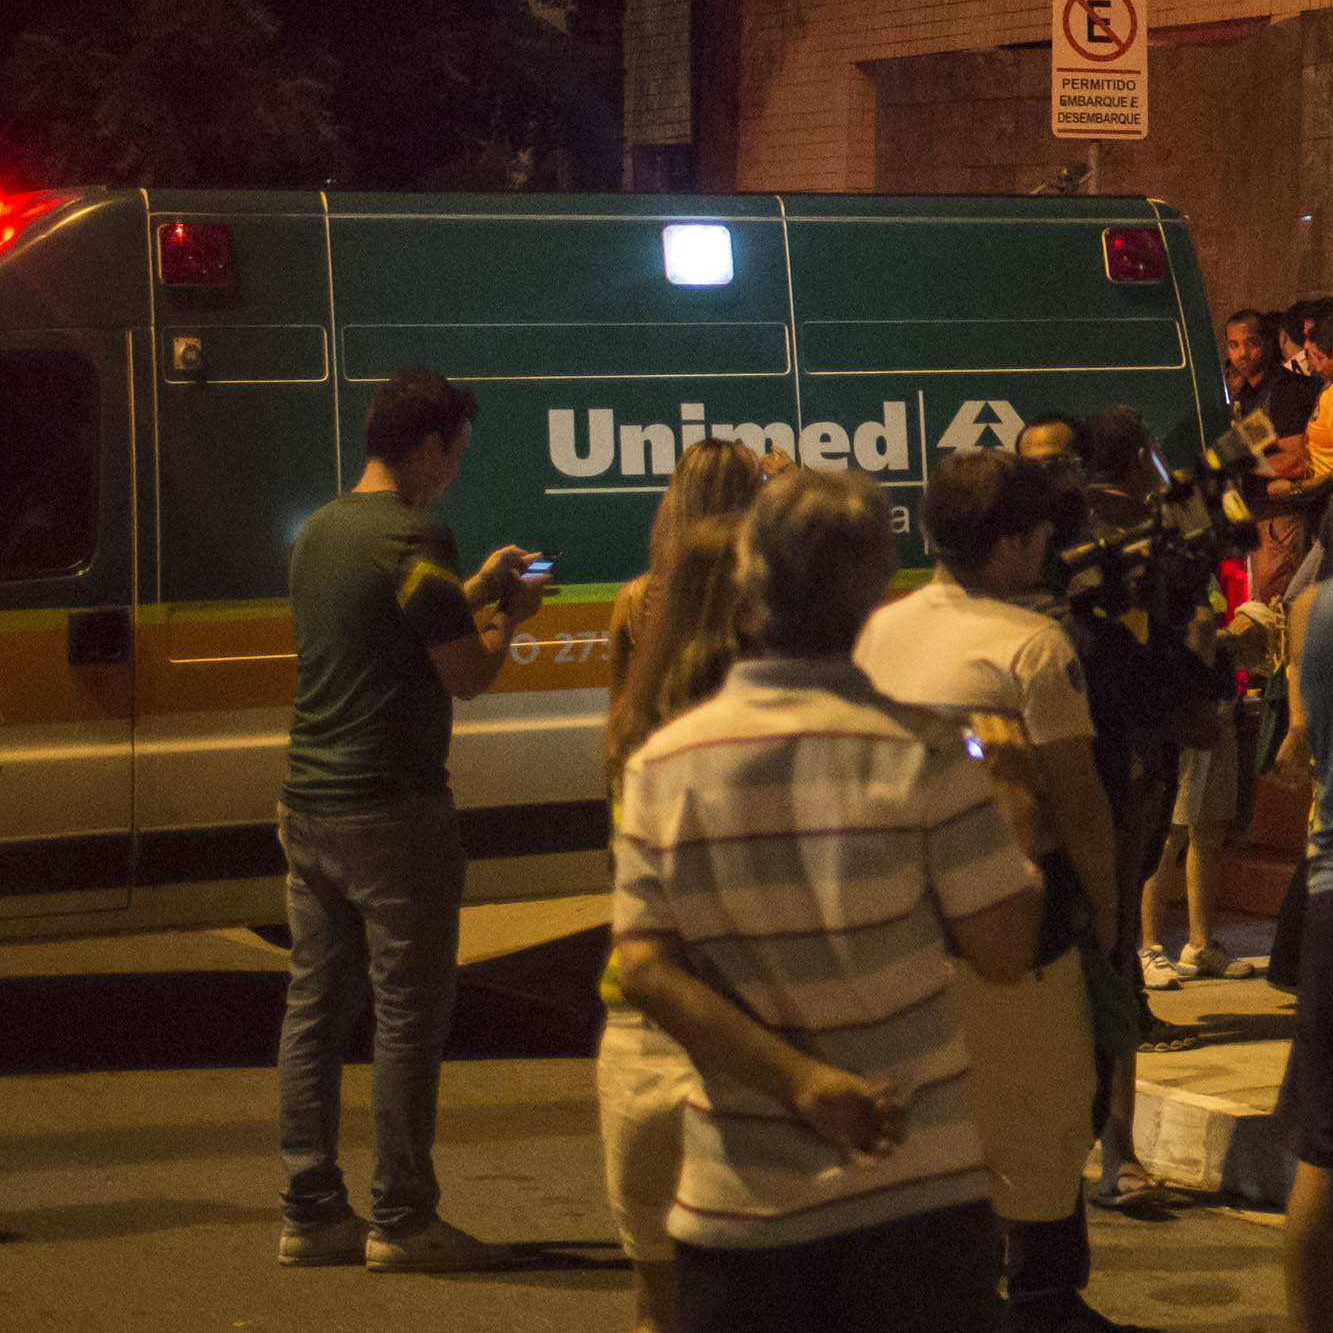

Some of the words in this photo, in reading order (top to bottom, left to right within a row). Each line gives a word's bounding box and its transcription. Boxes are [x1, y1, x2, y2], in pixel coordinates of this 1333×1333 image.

[1087, 0, 1113, 43] E
[1062, 78, 1136, 91] PERMITIDO
[1059, 95, 1128, 108] EMBARQUE
[1130, 97, 1139, 108] E
[1057, 112, 1141, 125] DESEMBARQUE
